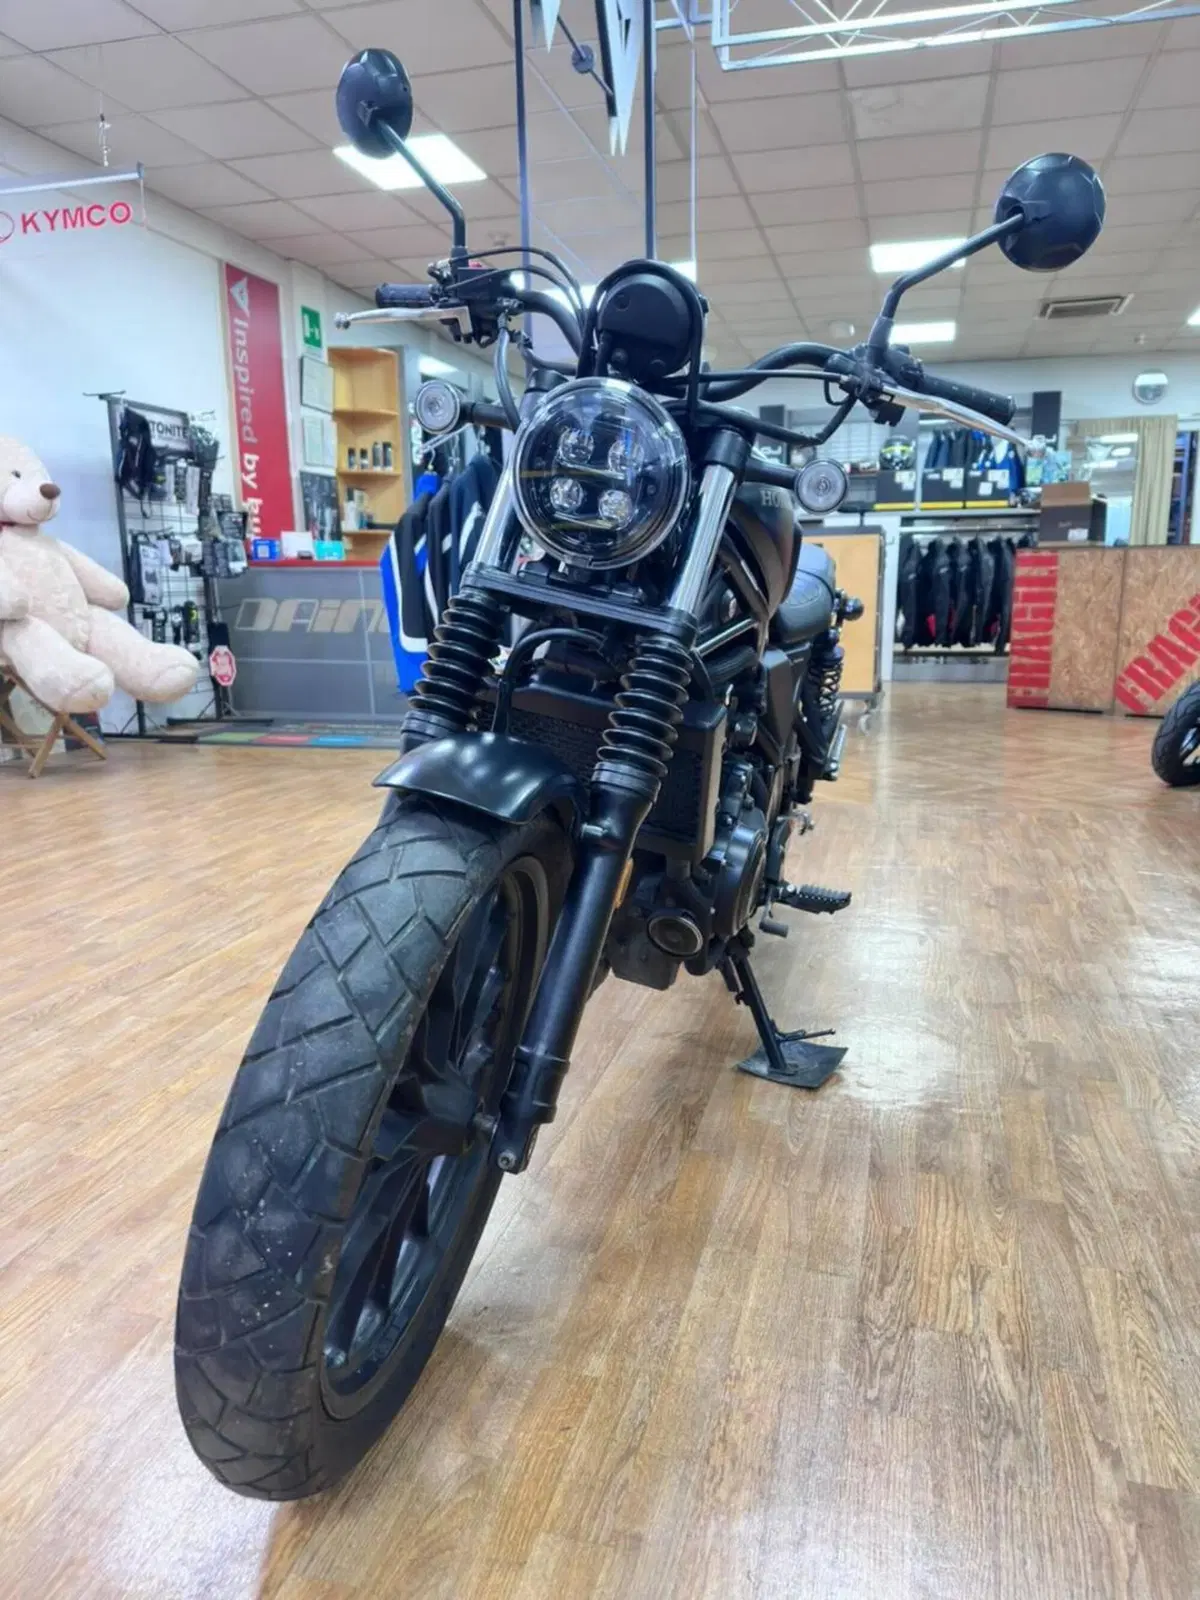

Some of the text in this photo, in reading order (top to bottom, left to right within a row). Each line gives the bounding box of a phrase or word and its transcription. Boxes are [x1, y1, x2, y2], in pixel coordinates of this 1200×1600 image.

[20, 200, 132, 234] KYMCO
[233, 317, 259, 444] Inspired
[149, 420, 189, 439] TONITE
[241, 453, 260, 490] by
[1114, 593, 1200, 714] FRAG
